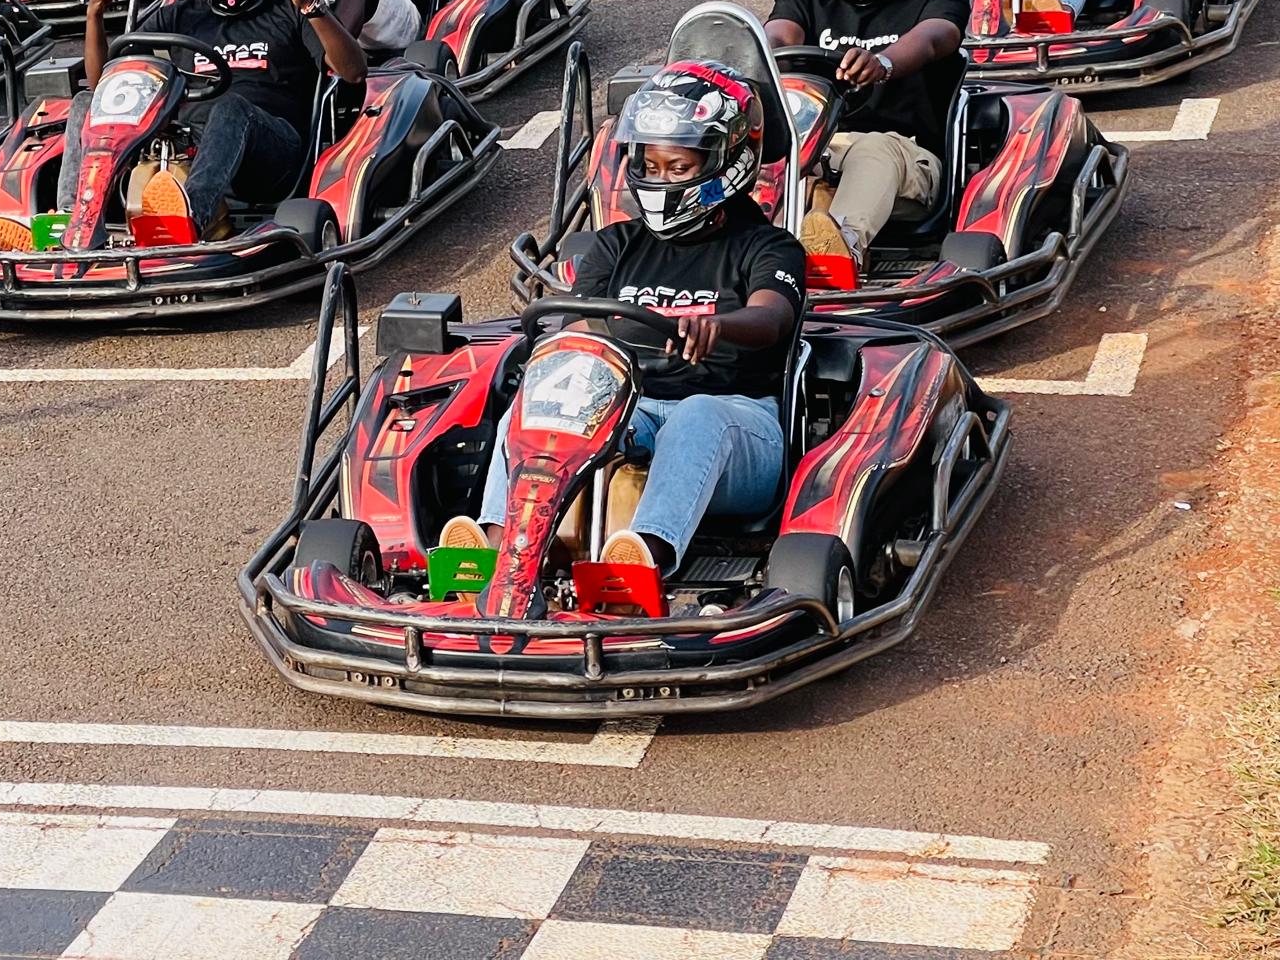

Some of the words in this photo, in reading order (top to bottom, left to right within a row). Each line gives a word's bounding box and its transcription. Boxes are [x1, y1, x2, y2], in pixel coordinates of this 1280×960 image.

[100, 72, 144, 115] 6
[702, 182, 723, 202] XL
[531, 355, 595, 417] 4
